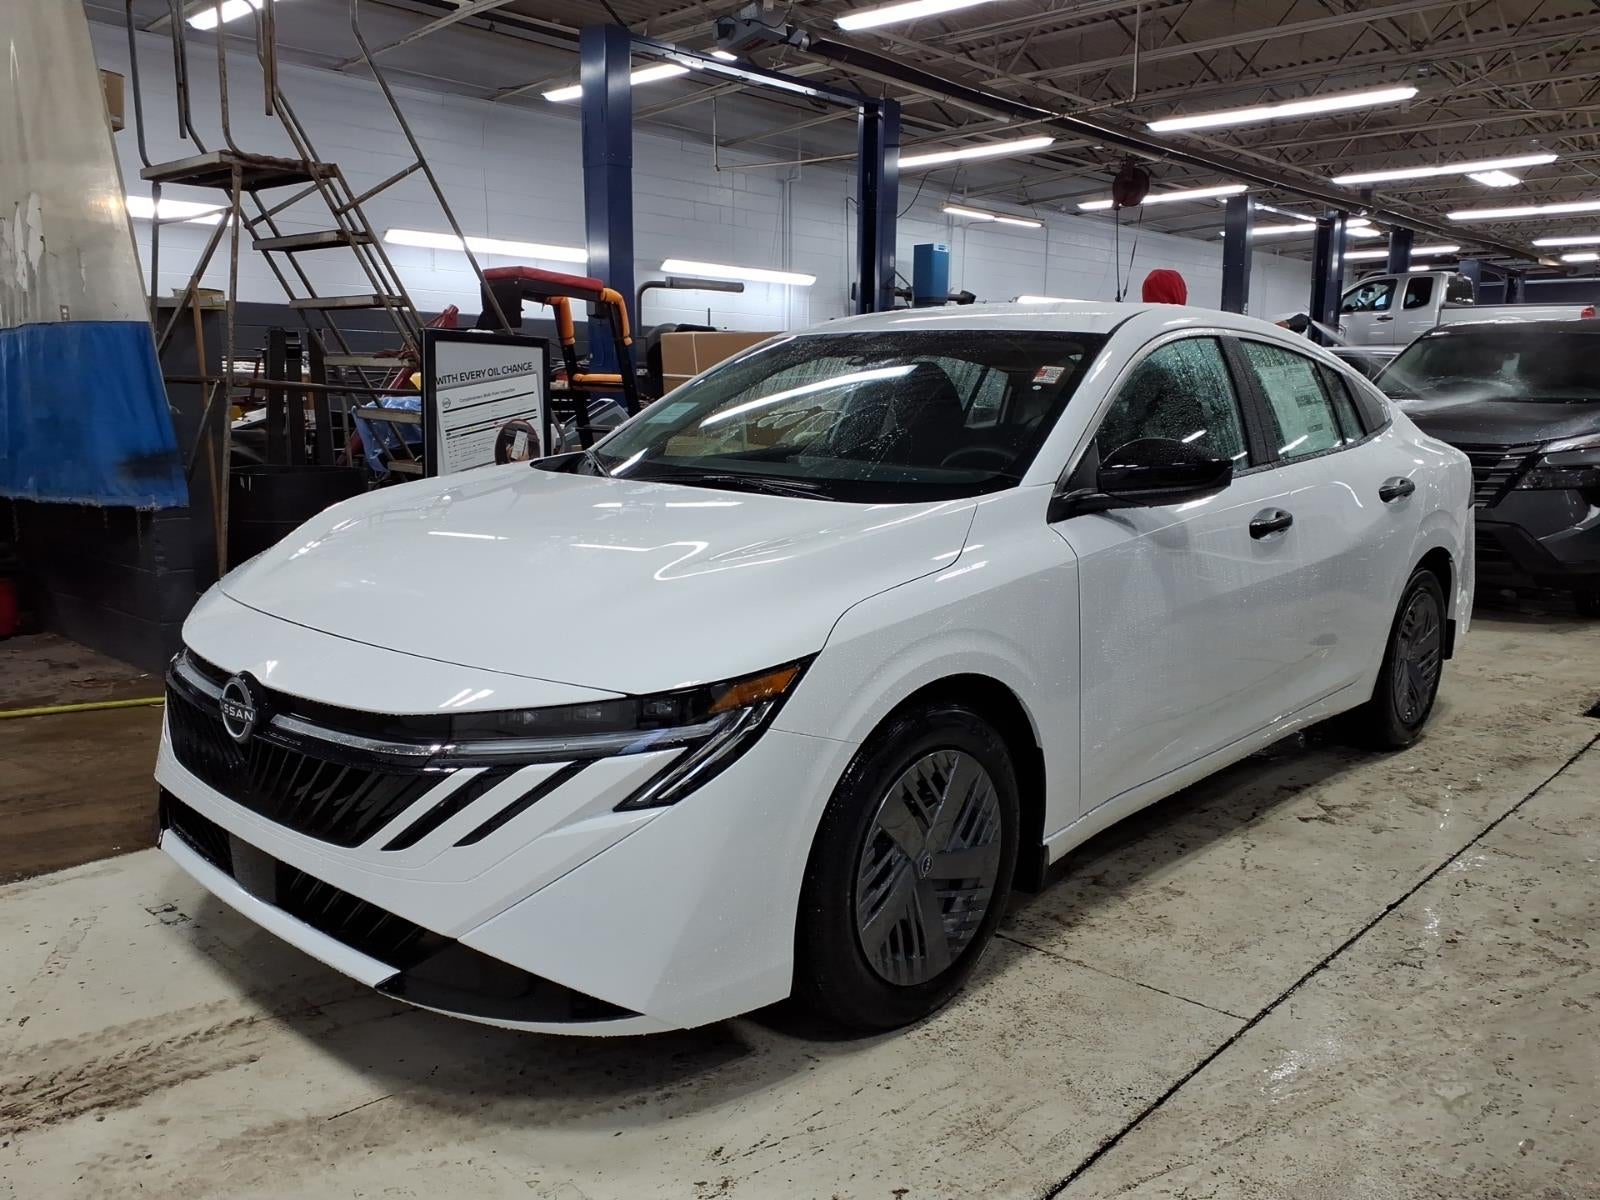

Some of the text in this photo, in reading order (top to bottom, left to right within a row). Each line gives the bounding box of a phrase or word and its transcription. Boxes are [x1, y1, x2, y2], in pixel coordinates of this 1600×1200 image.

[435, 362, 533, 385] WITH EVERY OIL CHANGE
